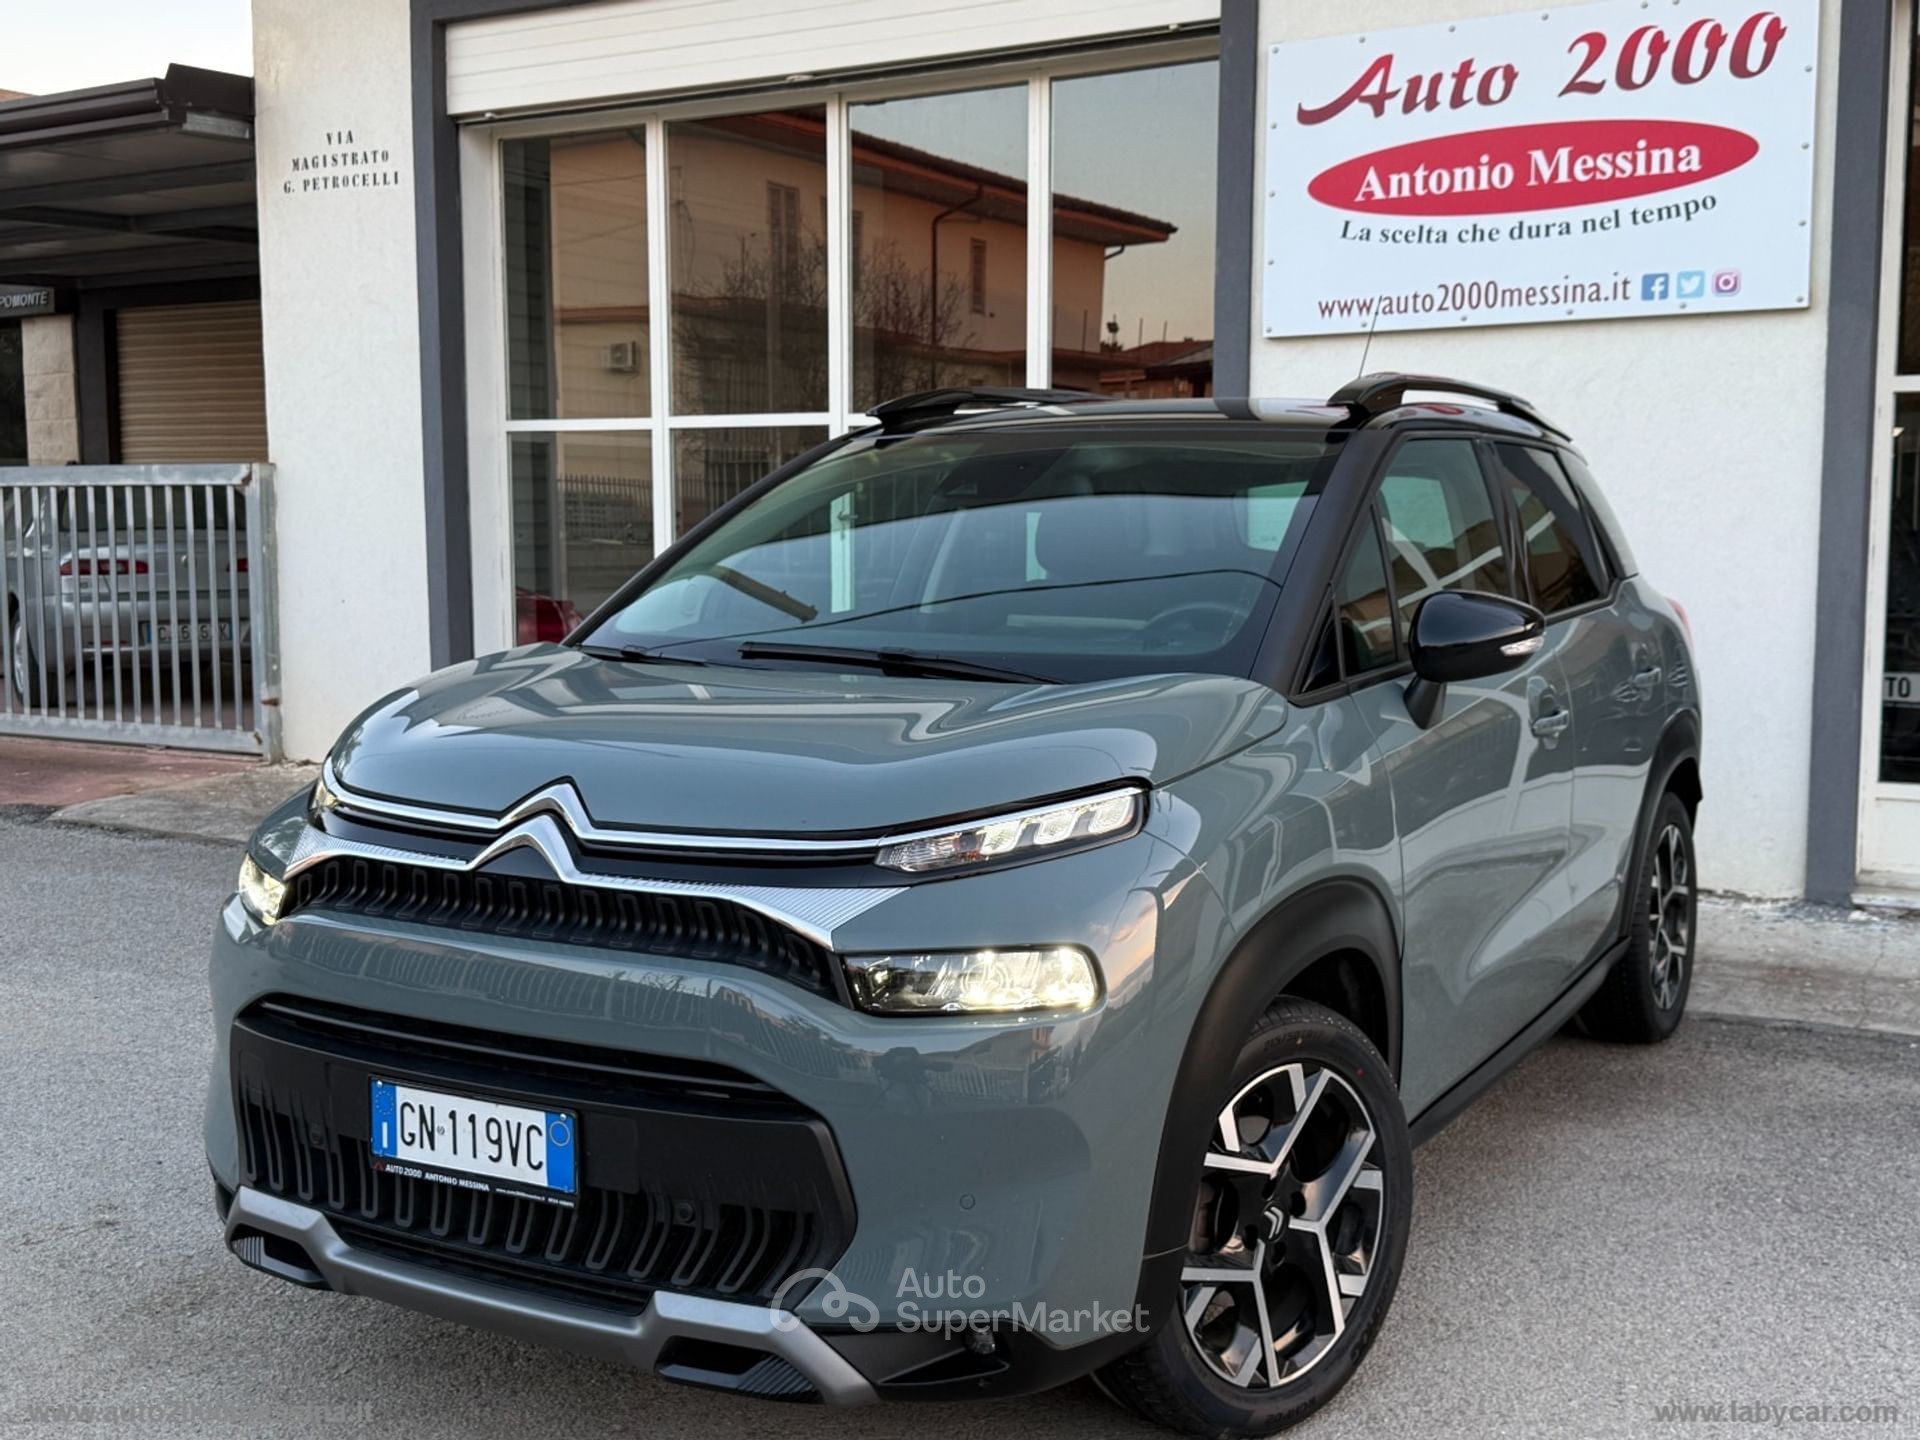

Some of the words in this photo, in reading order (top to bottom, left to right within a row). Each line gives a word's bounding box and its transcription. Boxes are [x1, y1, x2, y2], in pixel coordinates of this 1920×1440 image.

[1297, 53, 1519, 126] Auto
[1558, 12, 1787, 98] 2000
[326, 130, 354, 146] VIA
[292, 150, 389, 172] MAGISTRATO
[1355, 154, 1515, 202] Antonio
[1526, 141, 1703, 187] Messina
[283, 181, 295, 194] G.
[303, 171, 398, 192] PETROCELLI
[1340, 220, 1371, 242] La
[1379, 220, 1448, 245] scelta
[1457, 221, 1500, 243] che
[1509, 220, 1572, 241] dura
[1582, 209, 1621, 232] nel
[1631, 193, 1717, 227] tempo
[1318, 272, 1631, 319] www.auto2000messina.it
[385, 1163, 404, 1176] AUTO
[403, 1167, 422, 1179] 2000
[424, 1172, 458, 1186] ANTONIO
[458, 1179, 490, 1192] MESSINA
